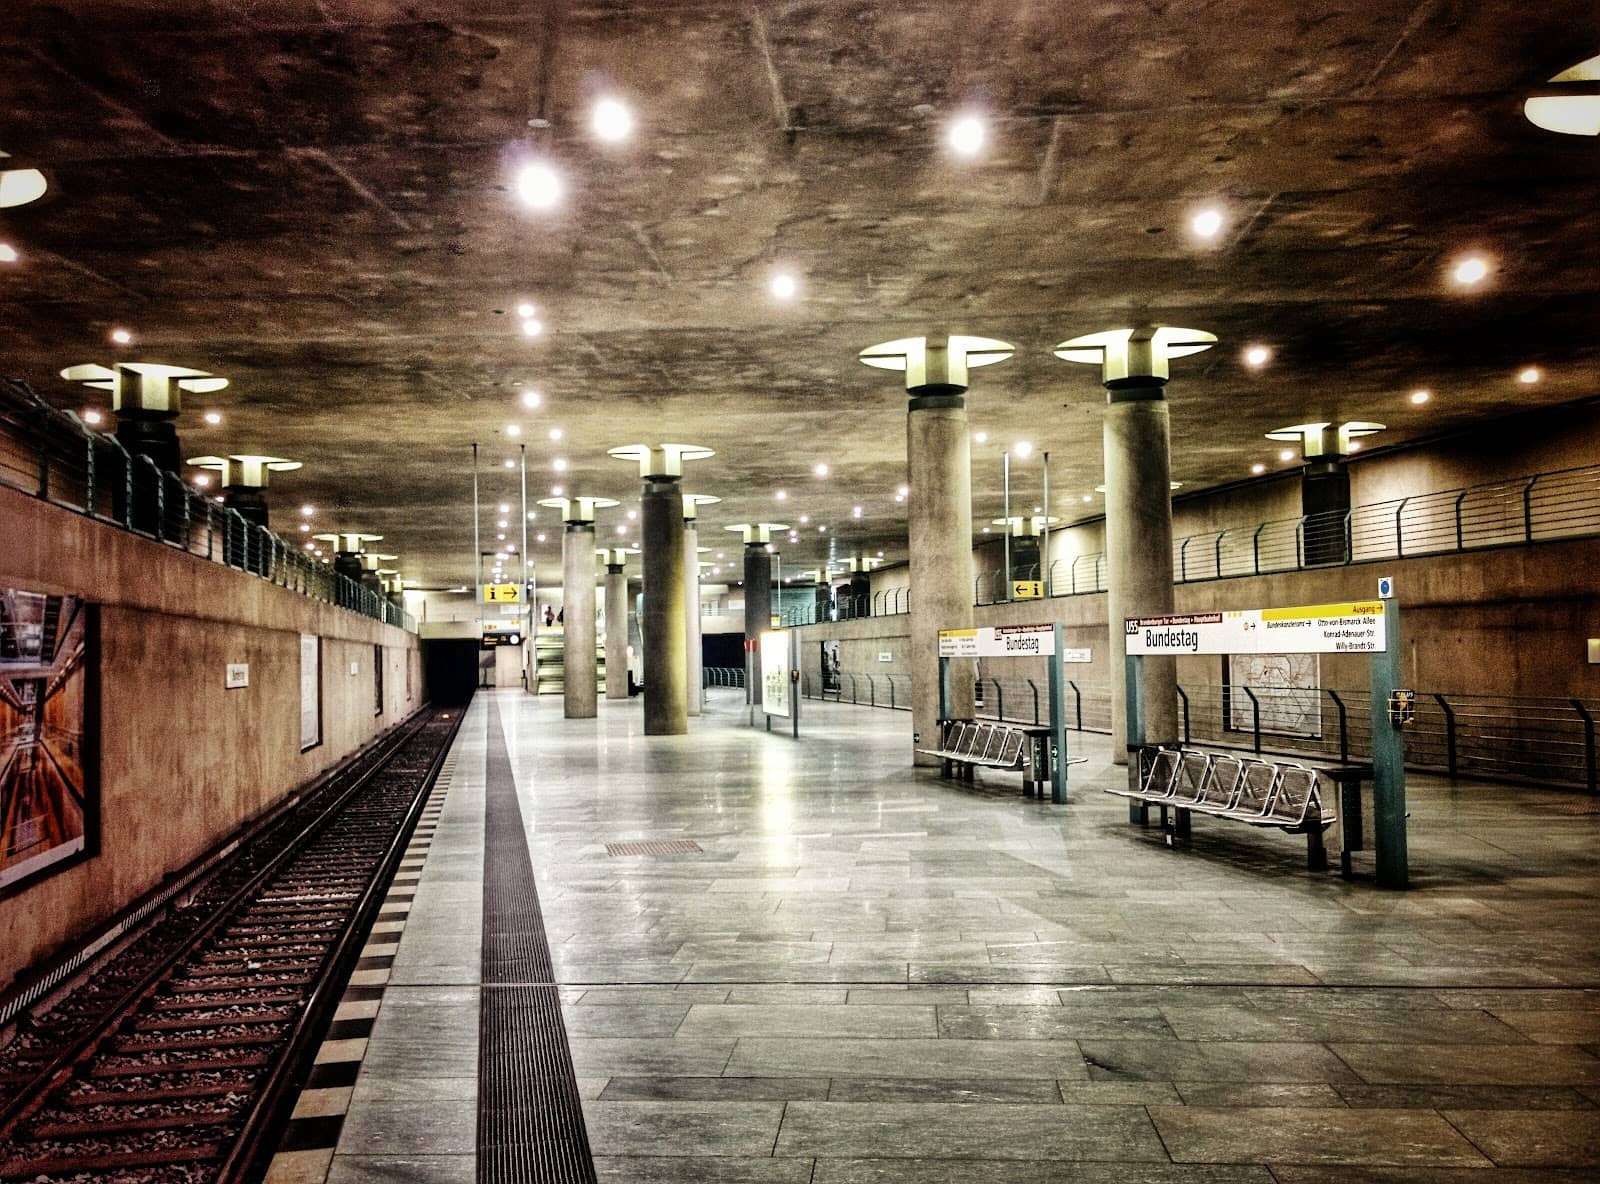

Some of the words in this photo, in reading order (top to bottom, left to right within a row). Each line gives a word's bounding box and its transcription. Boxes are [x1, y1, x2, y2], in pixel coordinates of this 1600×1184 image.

[1353, 605, 1376, 615] Ausgang
[1006, 635, 1039, 654] Bundestag
[1146, 627, 1198, 652] Bundestag
